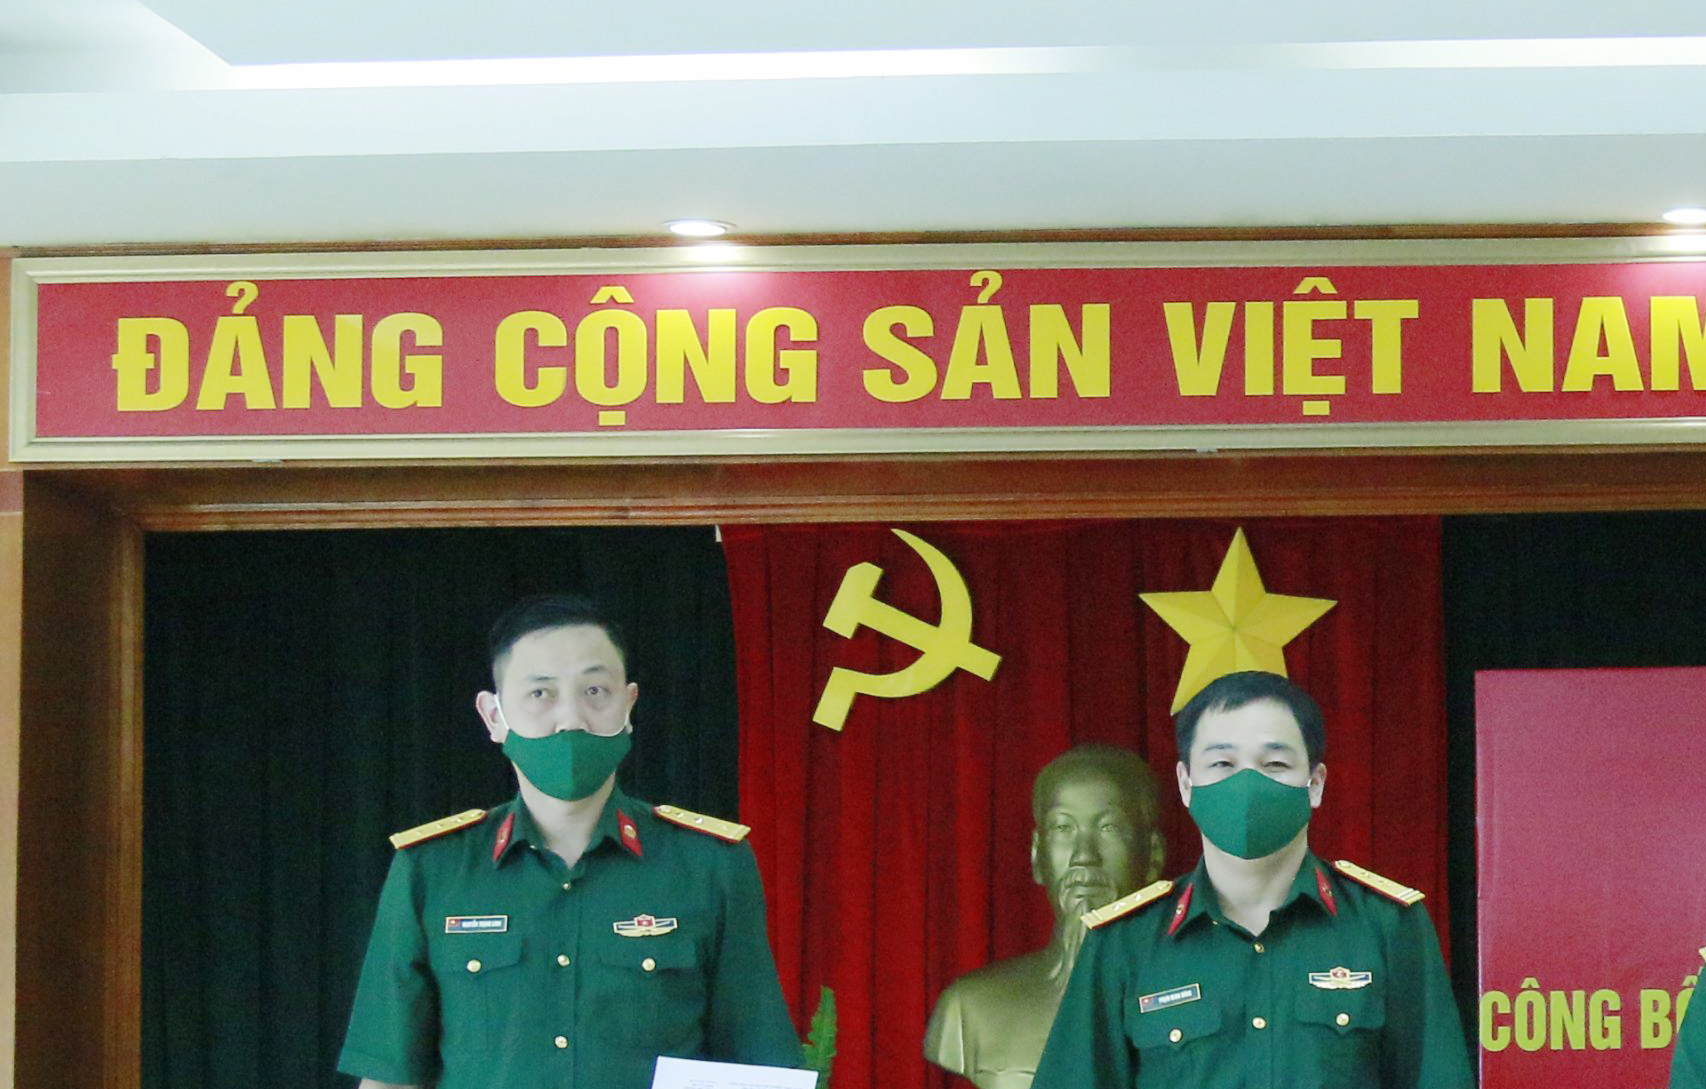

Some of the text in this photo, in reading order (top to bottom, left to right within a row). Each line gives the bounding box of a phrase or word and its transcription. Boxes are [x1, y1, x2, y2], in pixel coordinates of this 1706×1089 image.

[111, 279, 444, 413] ĐẢNG
[494, 285, 818, 427] CỘNG
[863, 269, 1111, 403] SẢN
[1162, 276, 1420, 417] VIỆT
[1479, 976, 1622, 1052] CÔNG
